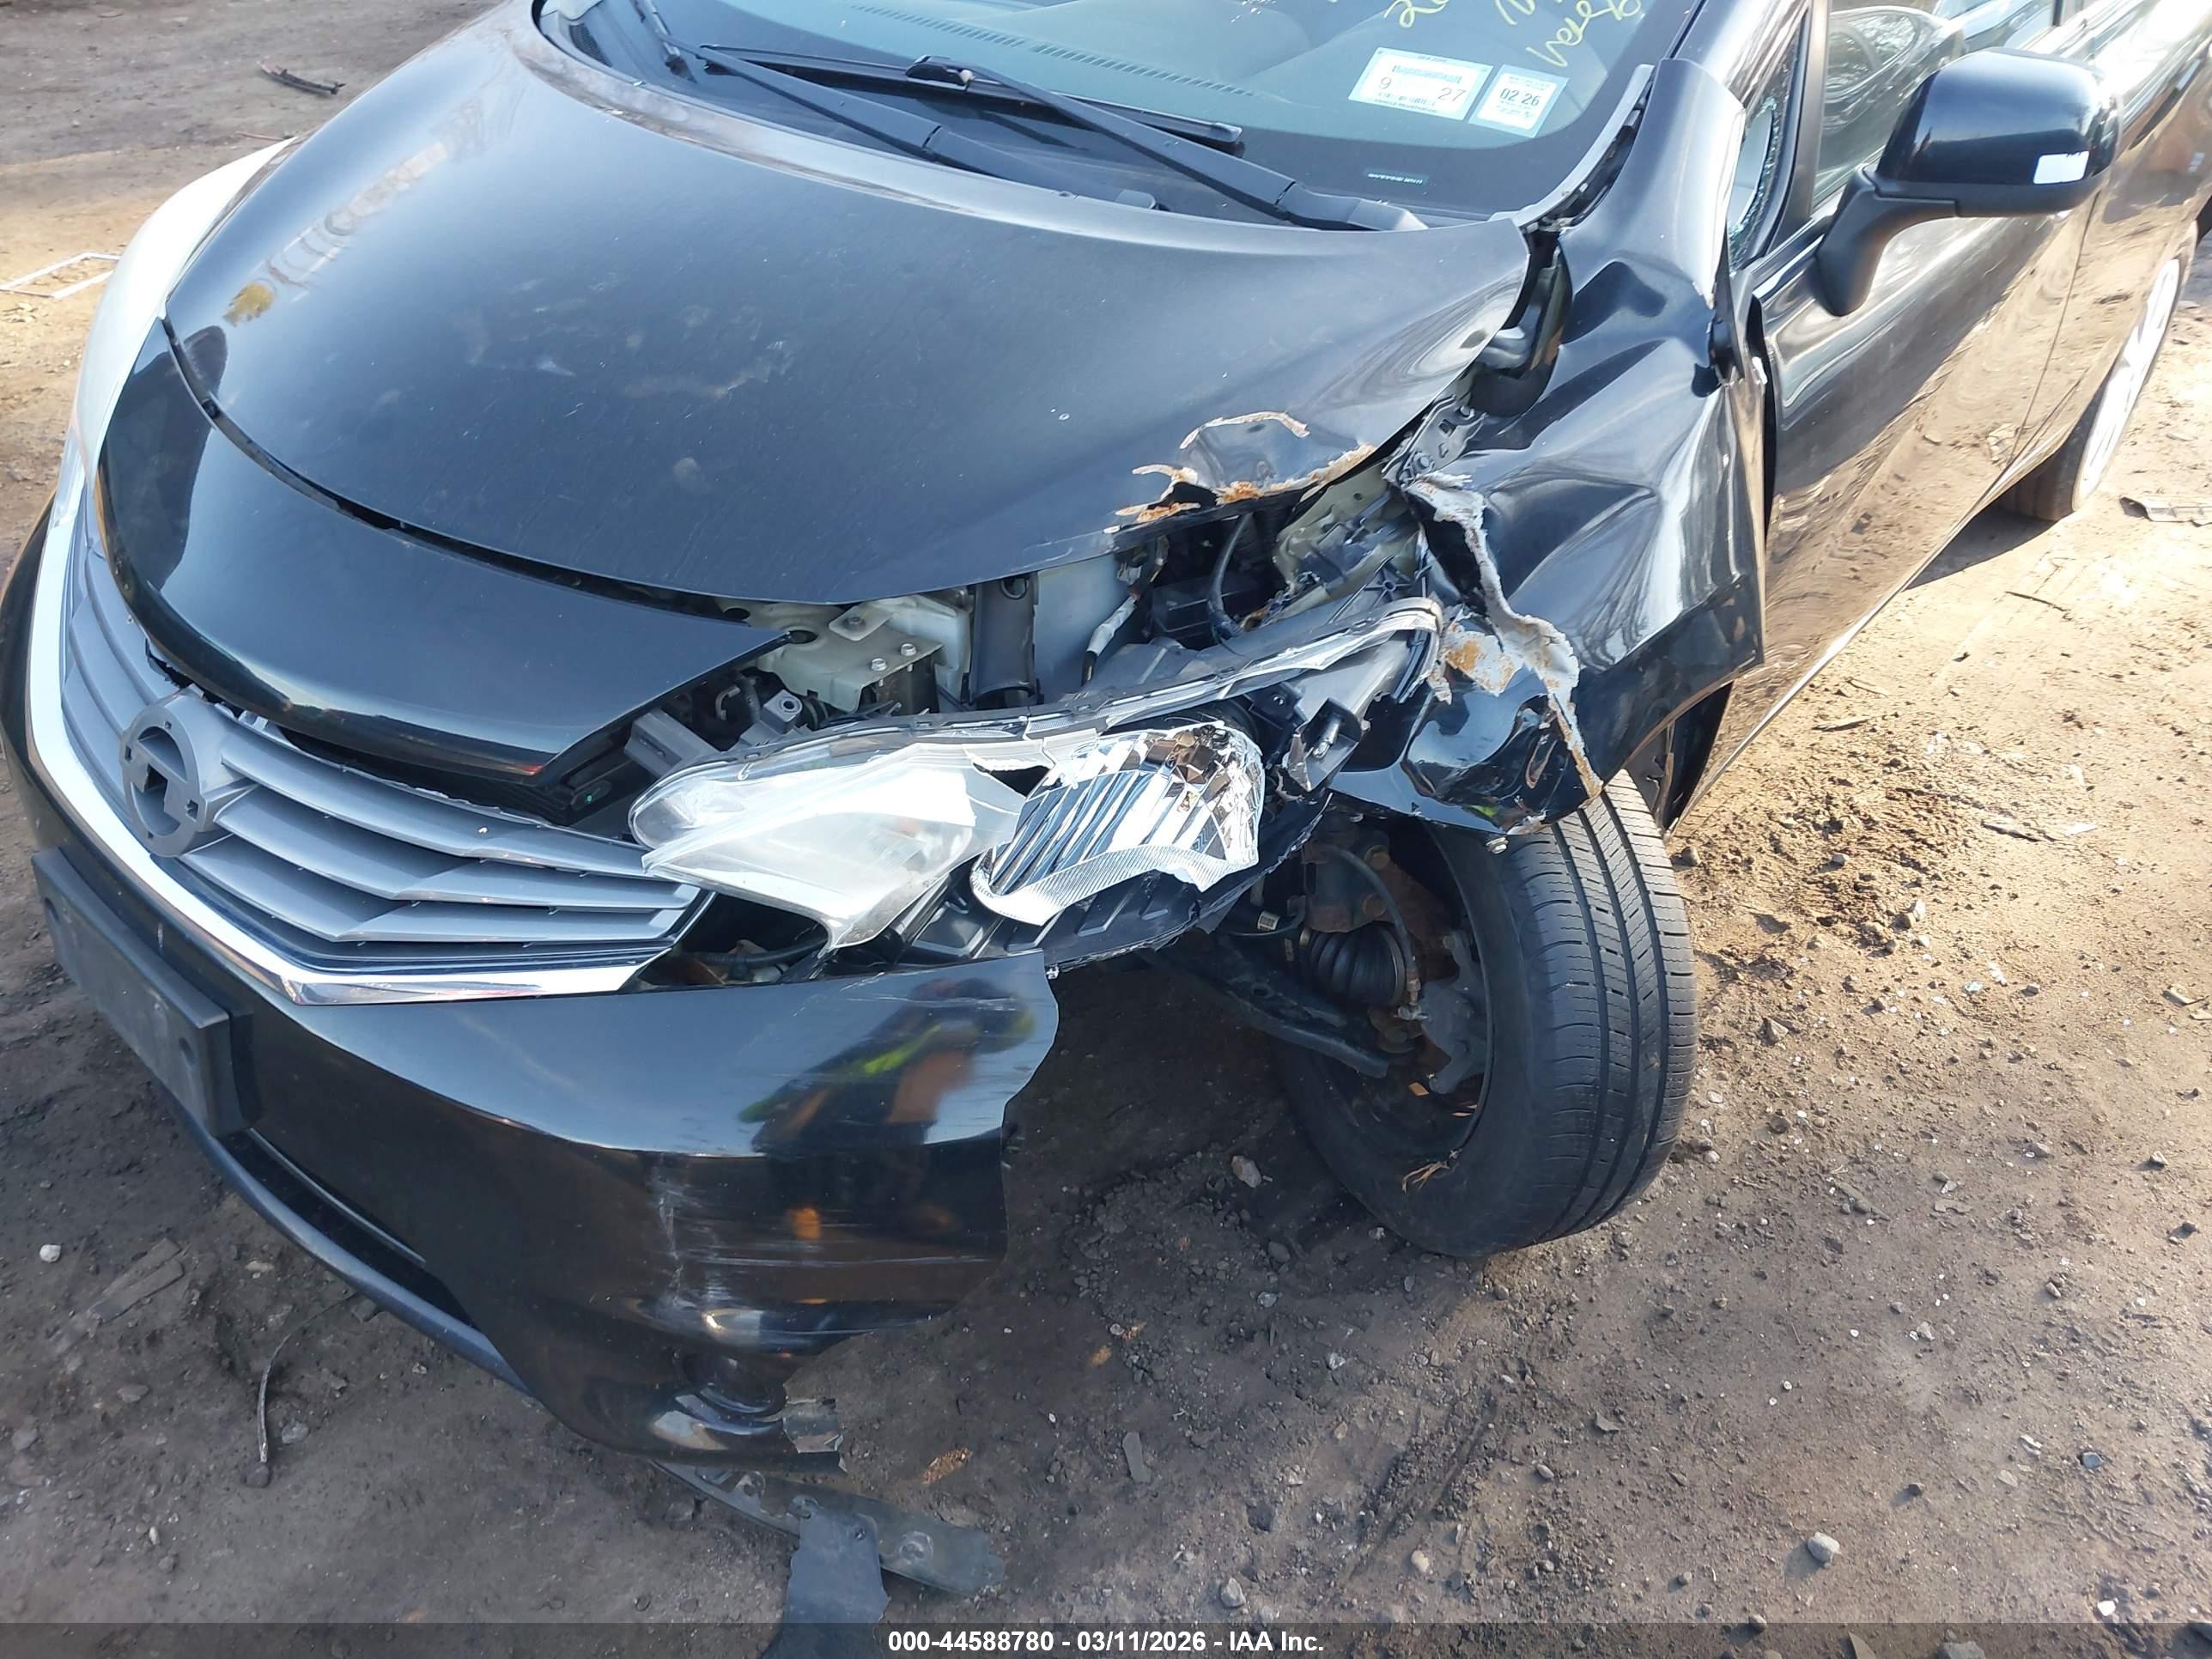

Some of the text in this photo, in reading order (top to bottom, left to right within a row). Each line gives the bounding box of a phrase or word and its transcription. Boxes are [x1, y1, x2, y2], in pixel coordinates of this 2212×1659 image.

[1437, 87, 1467, 102] 27
[1499, 88, 1541, 106] 02 26
